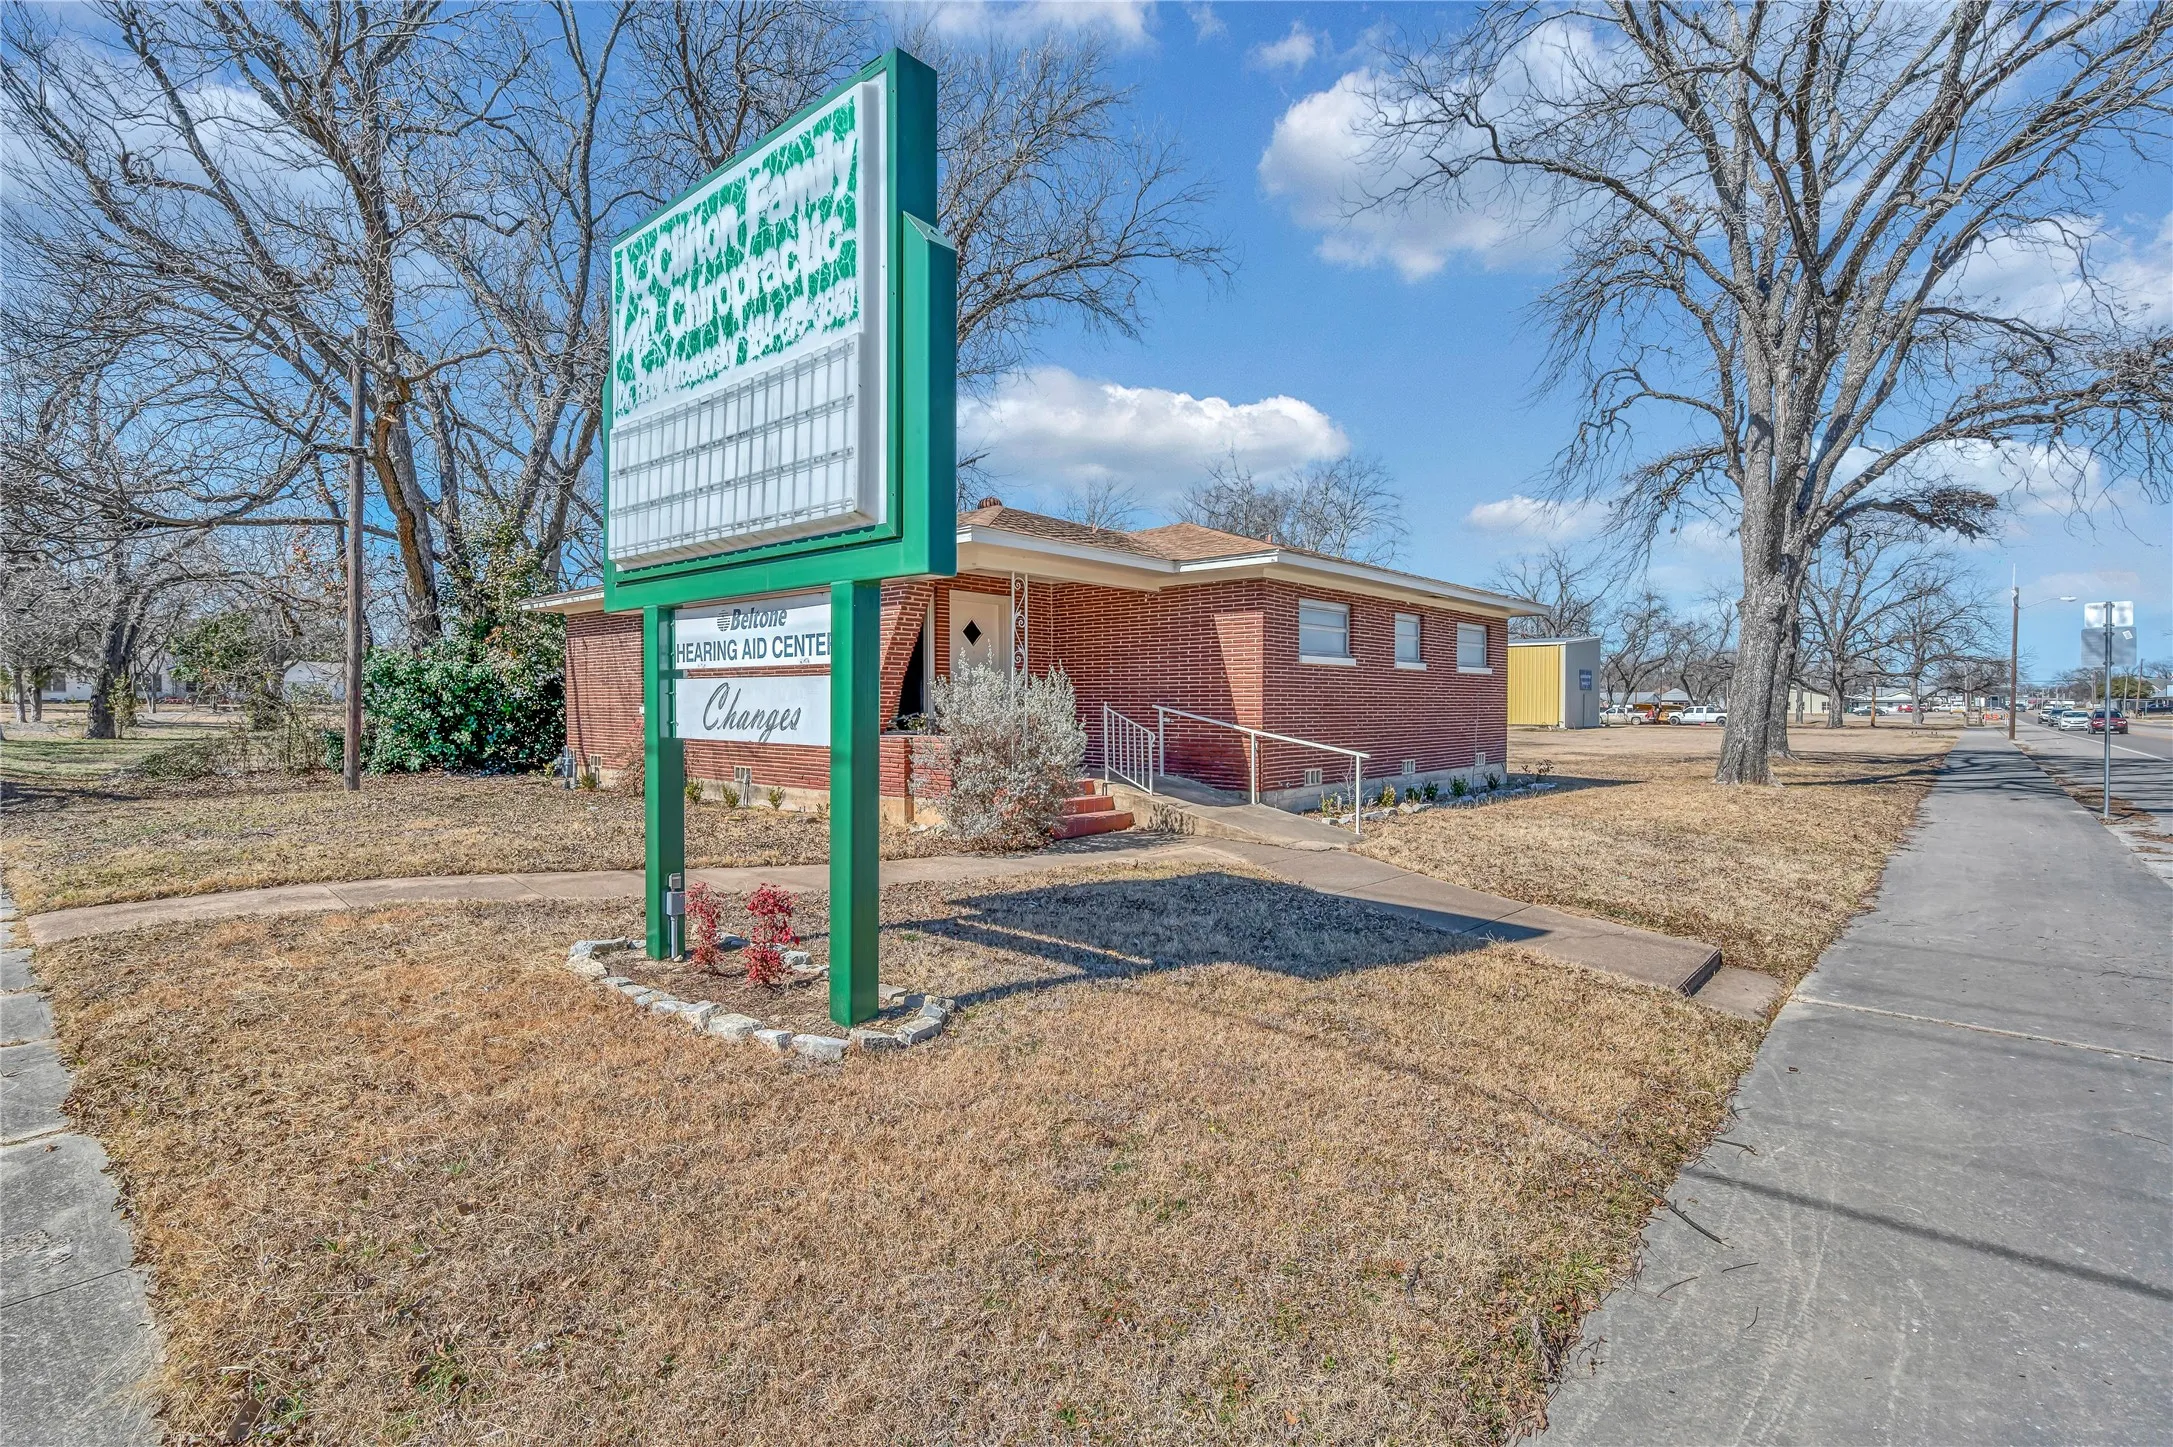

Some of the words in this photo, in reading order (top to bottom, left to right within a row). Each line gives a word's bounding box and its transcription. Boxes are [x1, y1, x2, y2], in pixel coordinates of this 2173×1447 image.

[750, 130, 856, 230] Family
[666, 208, 843, 337] Chiropractic
[677, 639, 738, 663] HEARING
[742, 637, 767, 660] AID
[730, 608, 787, 631] Beltone
[703, 682, 802, 743] Changes
